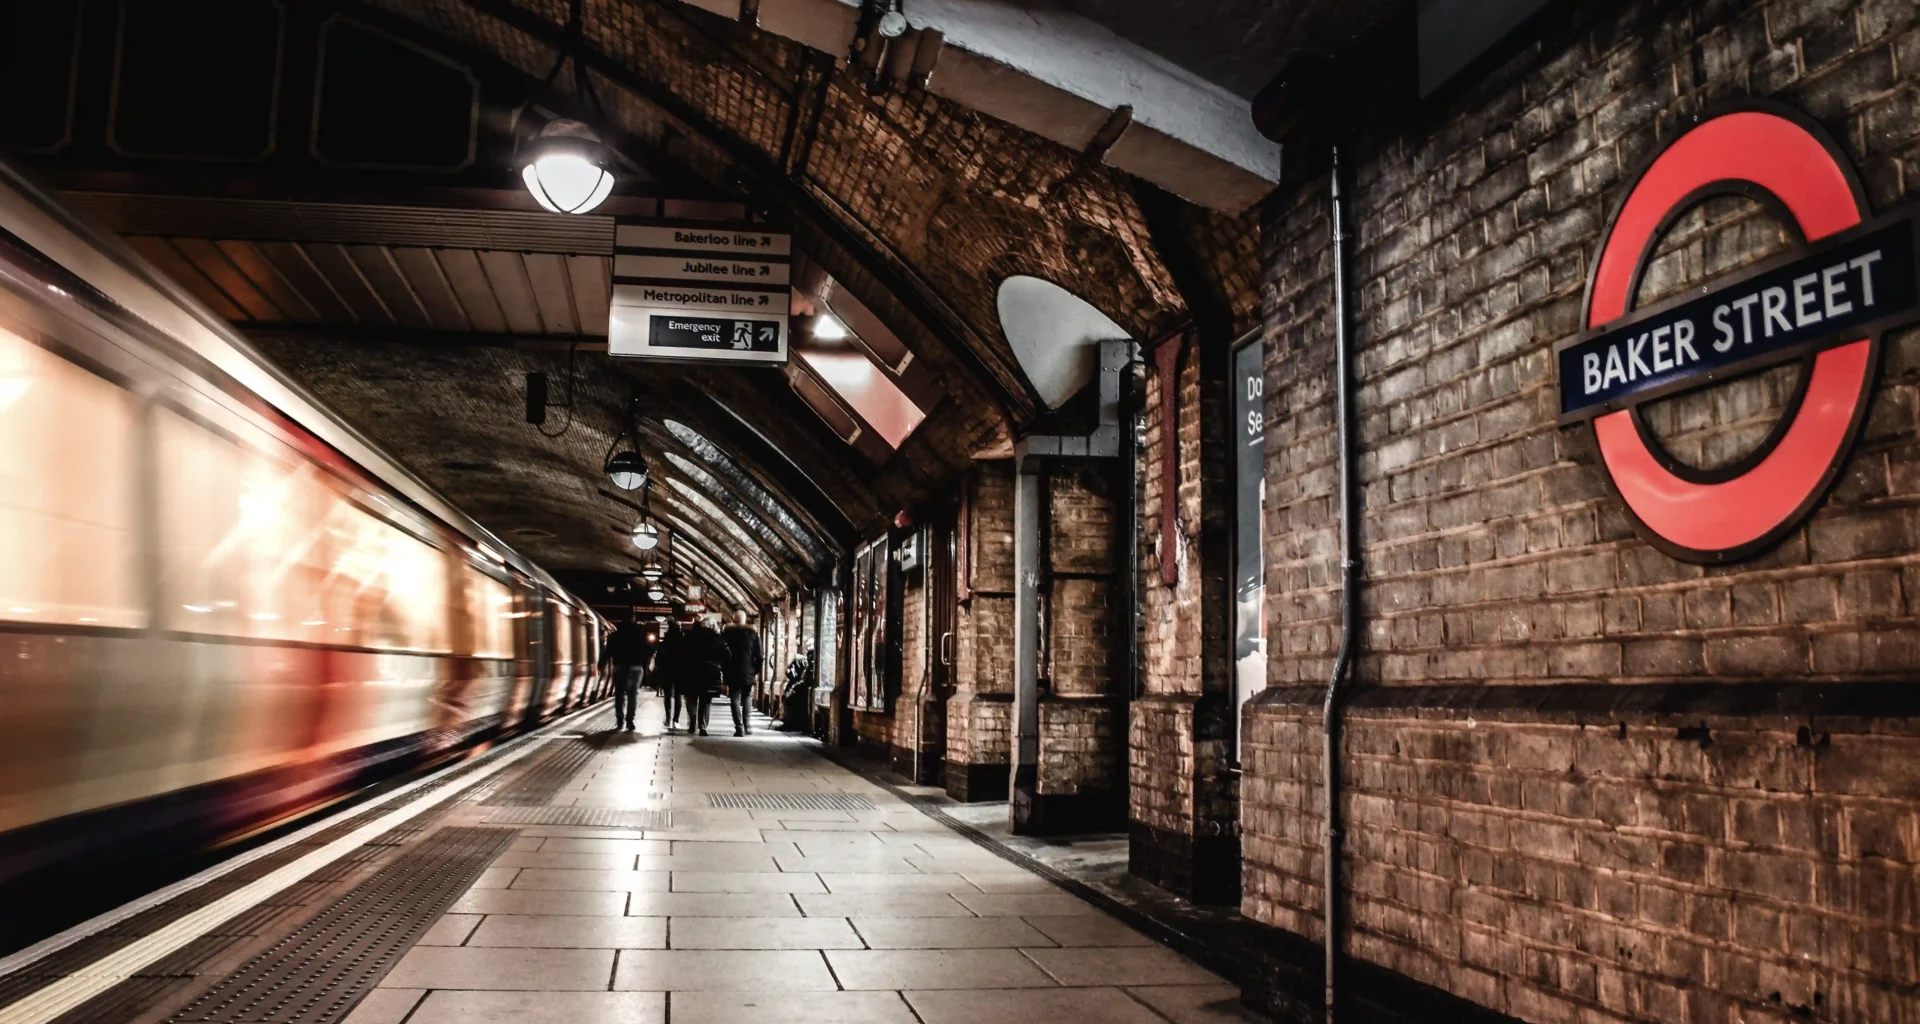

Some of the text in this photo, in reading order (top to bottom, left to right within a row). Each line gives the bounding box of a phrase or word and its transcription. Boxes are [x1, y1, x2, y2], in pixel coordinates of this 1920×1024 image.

[674, 231, 757, 247] Bakerloo line
[682, 262, 756, 277] Jubilee line
[644, 289, 754, 306] Metropolitan line
[1583, 249, 1882, 395] BAKER STREET
[668, 320, 722, 343] Emergency exit
